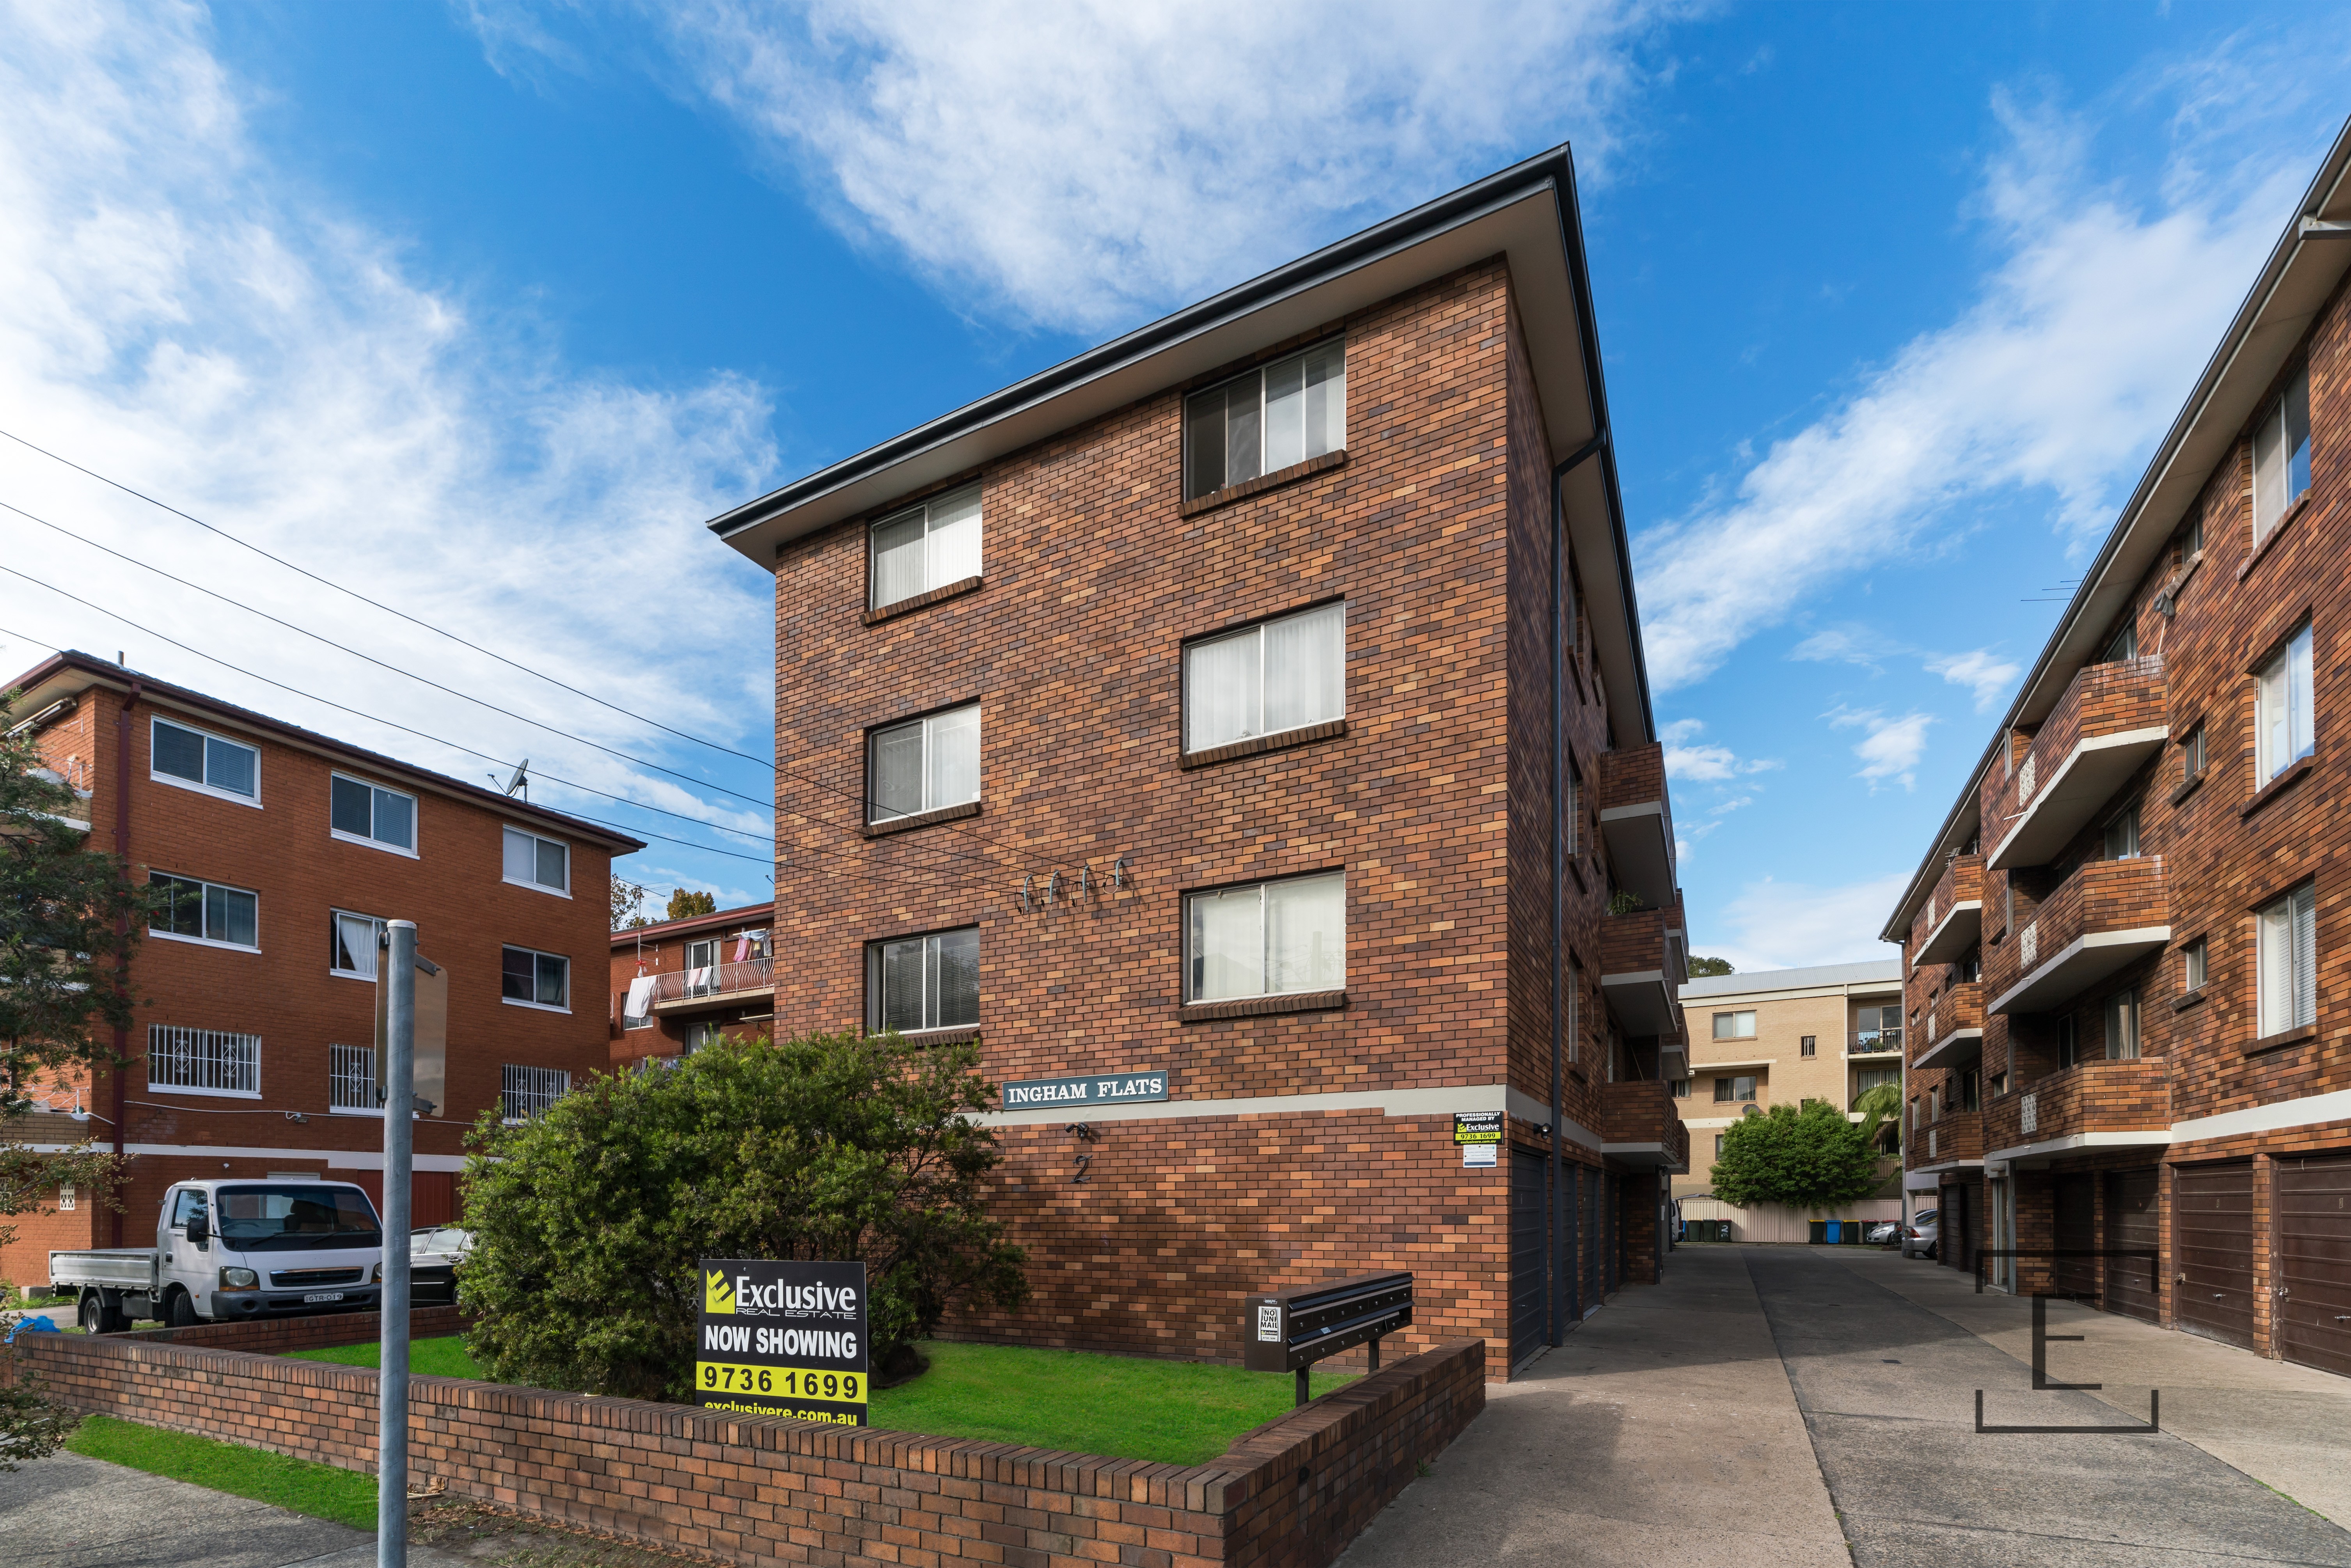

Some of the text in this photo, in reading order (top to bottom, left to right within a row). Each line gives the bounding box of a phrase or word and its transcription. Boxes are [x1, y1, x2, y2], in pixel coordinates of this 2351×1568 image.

[1008, 1078, 1162, 1103] INGHAM FLATS
[1071, 1154, 1092, 1183] 2
[736, 1276, 856, 1311] Exclusive
[736, 1308, 856, 1320] REAL ESTATE
[705, 1325, 857, 1359] NOW SHOWING
[704, 1366, 858, 1399] 9736 1699
